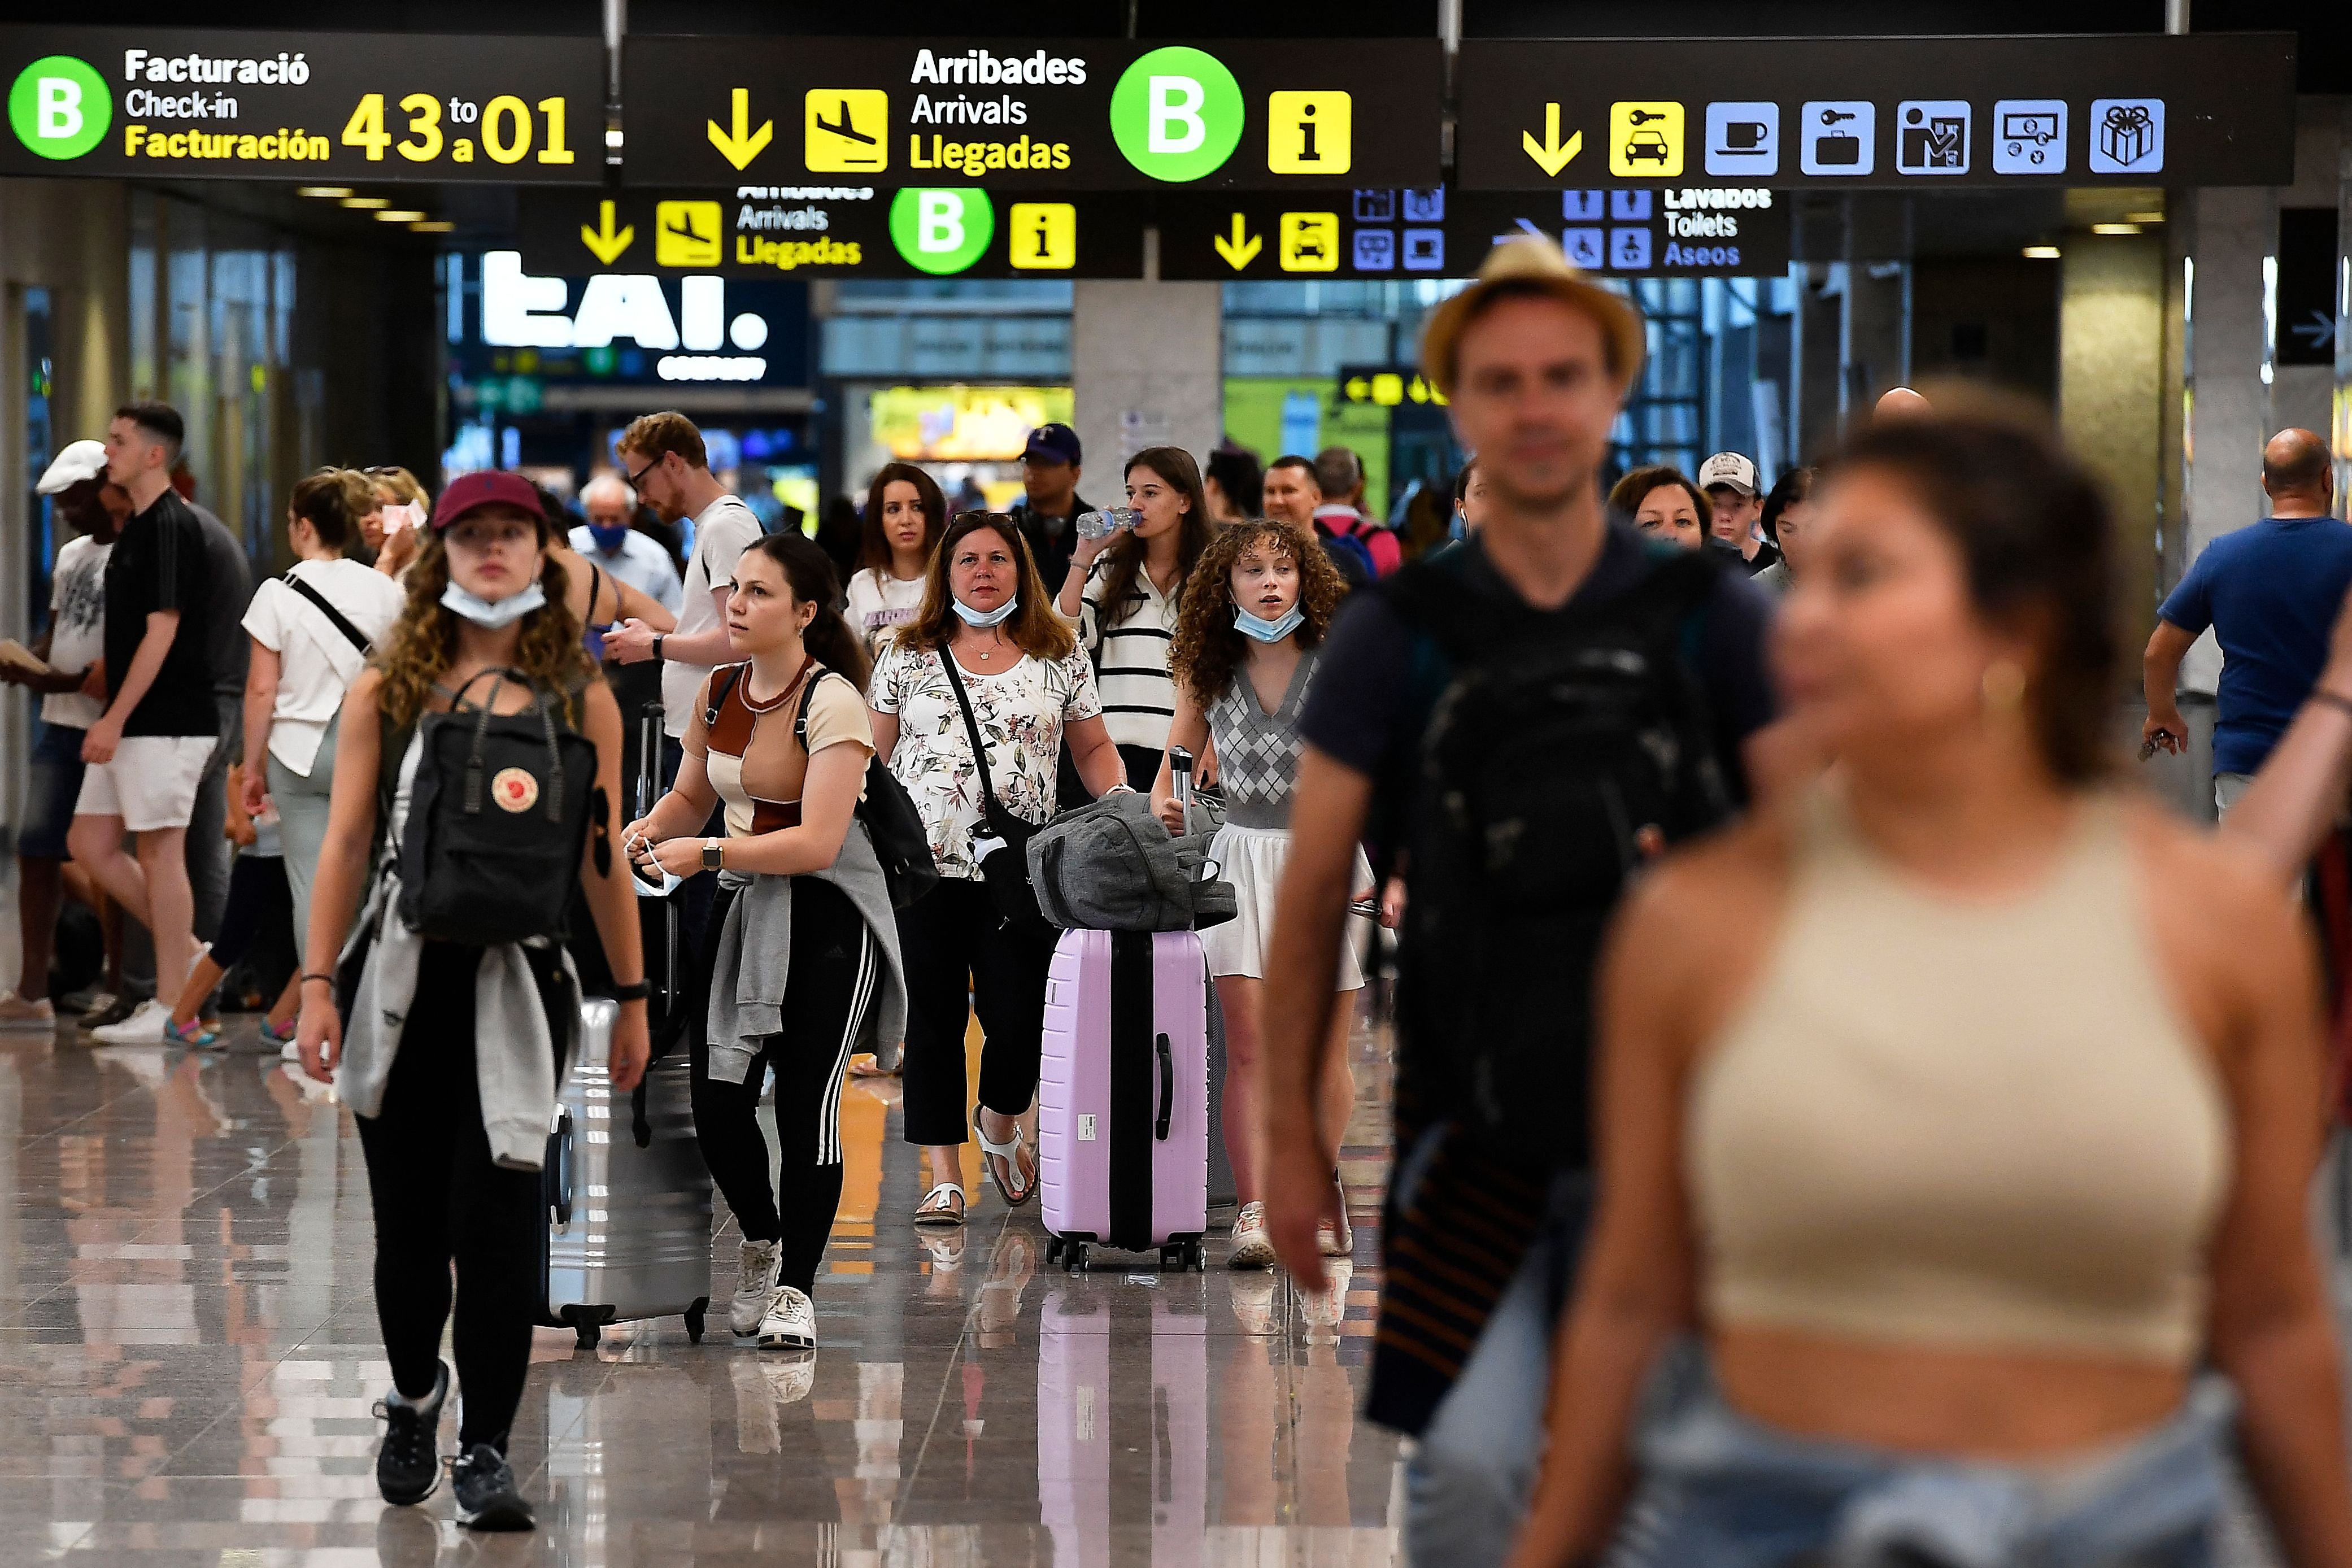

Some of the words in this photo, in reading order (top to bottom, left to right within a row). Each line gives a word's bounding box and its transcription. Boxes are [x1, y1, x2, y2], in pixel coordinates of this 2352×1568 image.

[125, 49, 310, 85] Facturació
[910, 49, 1087, 85] Arribades
[38, 77, 84, 138] B
[125, 89, 238, 119] Check-in
[910, 94, 1027, 125] Arrivals
[1148, 75, 1206, 154] B
[125, 125, 330, 160] Facturación
[341, 93, 443, 163] 43
[448, 97, 478, 123] to
[480, 95, 574, 164] 01
[452, 136, 474, 163] a
[910, 134, 1071, 177] Llegadas
[736, 204, 829, 231] Arrivals
[918, 190, 965, 253] B
[1663, 211, 1738, 237] Toilets
[735, 234, 863, 271] Llegadas
